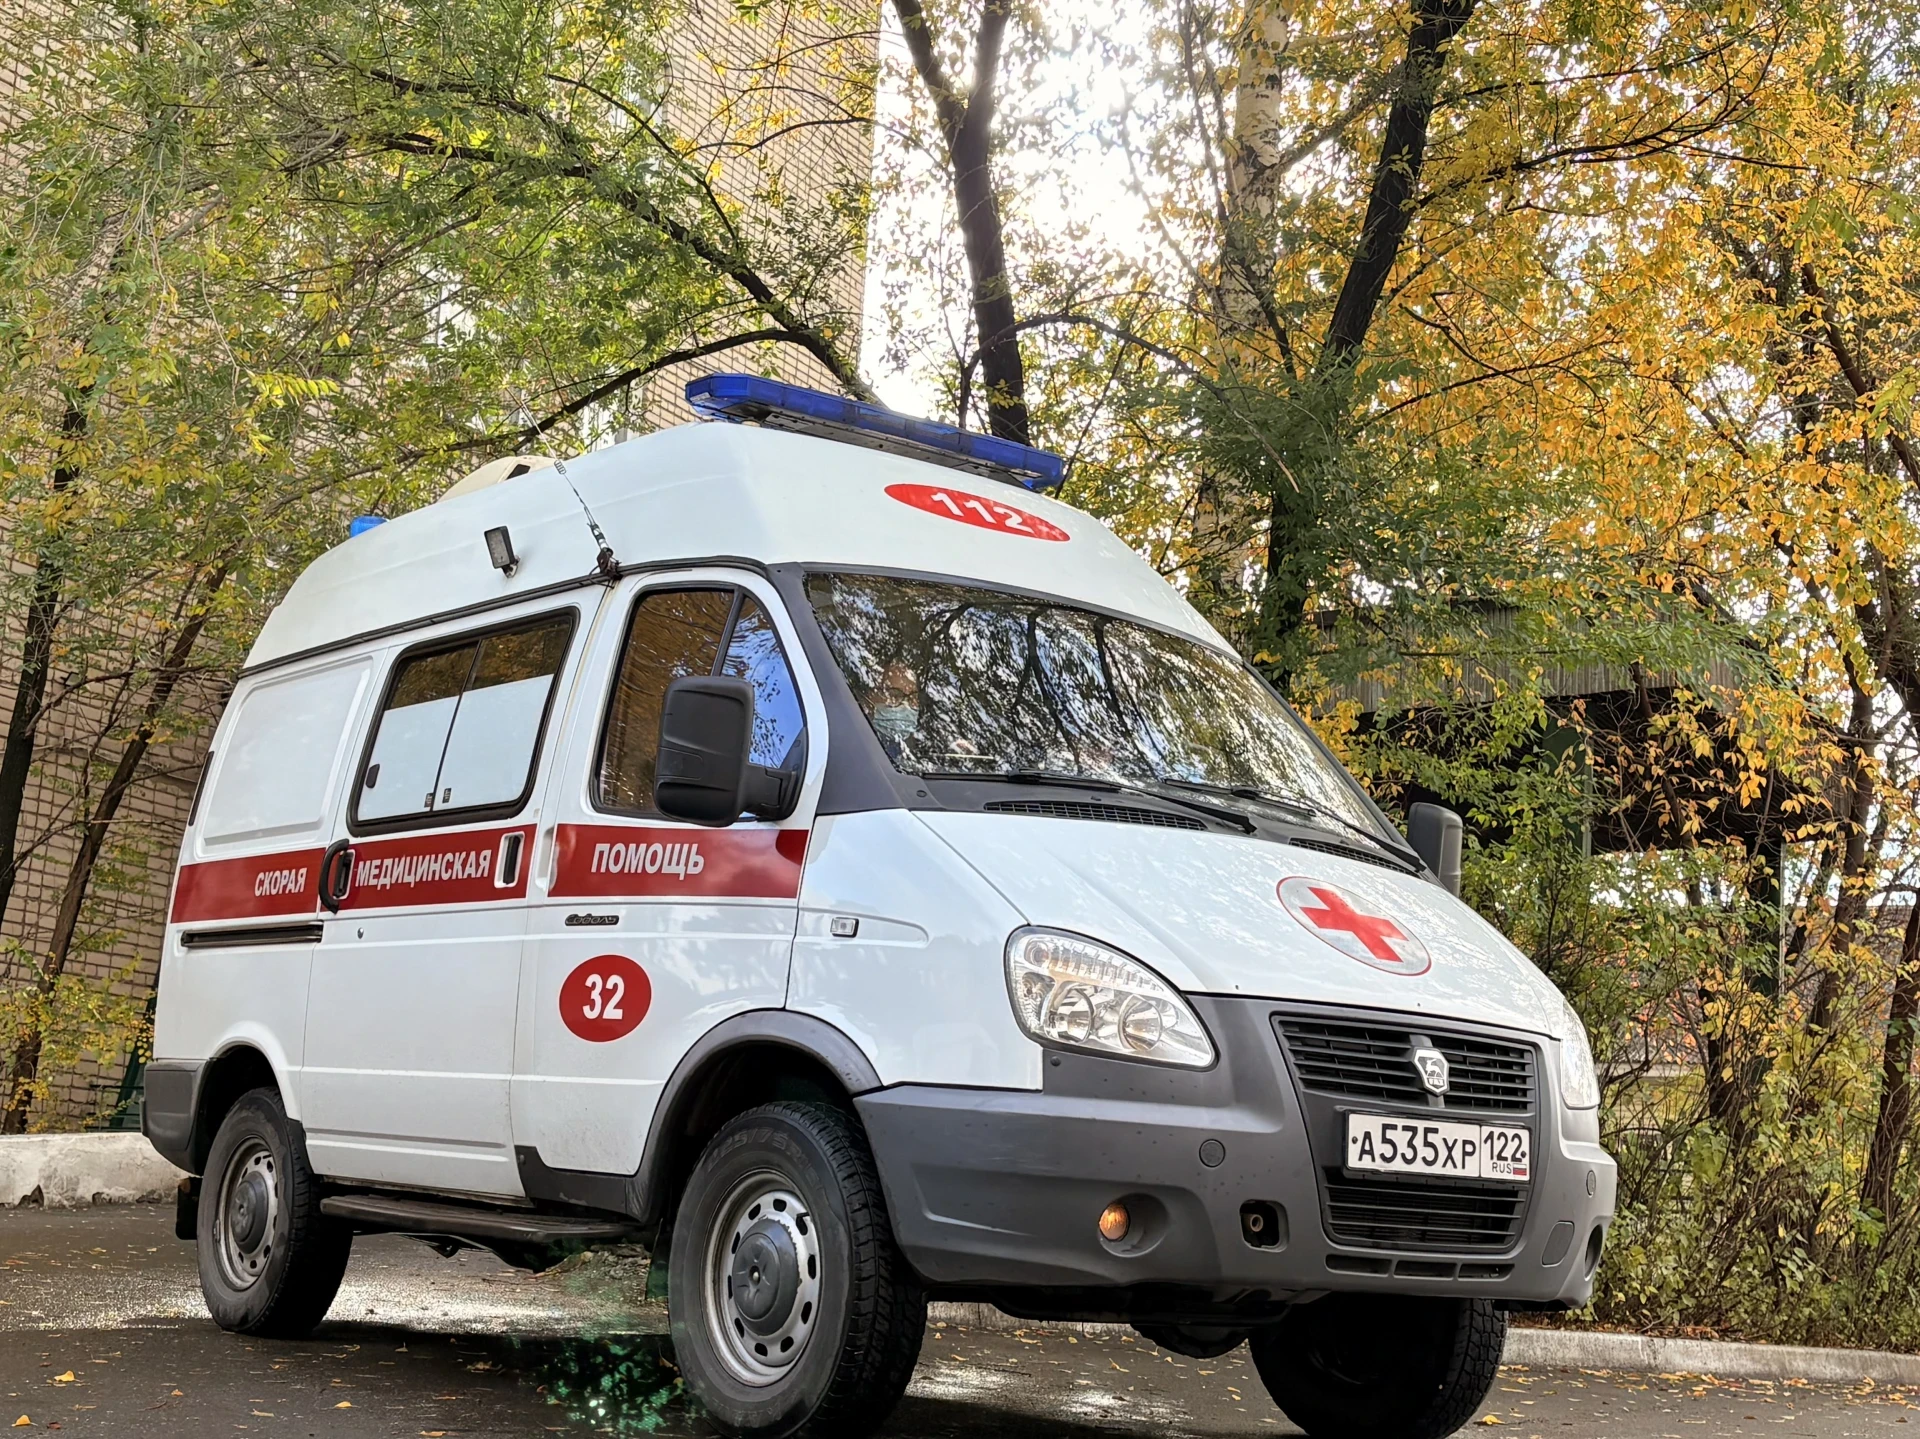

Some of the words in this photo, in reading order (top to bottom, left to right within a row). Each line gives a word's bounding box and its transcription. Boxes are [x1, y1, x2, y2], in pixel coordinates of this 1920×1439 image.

[931, 492, 1034, 533] 112
[254, 867, 307, 896] СКОРАЯ
[355, 849, 492, 891] МЕДИЦИНСКАЯ
[591, 842, 705, 880] ПОМОЩЬ
[582, 973, 625, 1020] 32
[1358, 1123, 1477, 1170] А535ХР
[1483, 1130, 1523, 1163] 122
[1492, 1161, 1512, 1174] RUS
